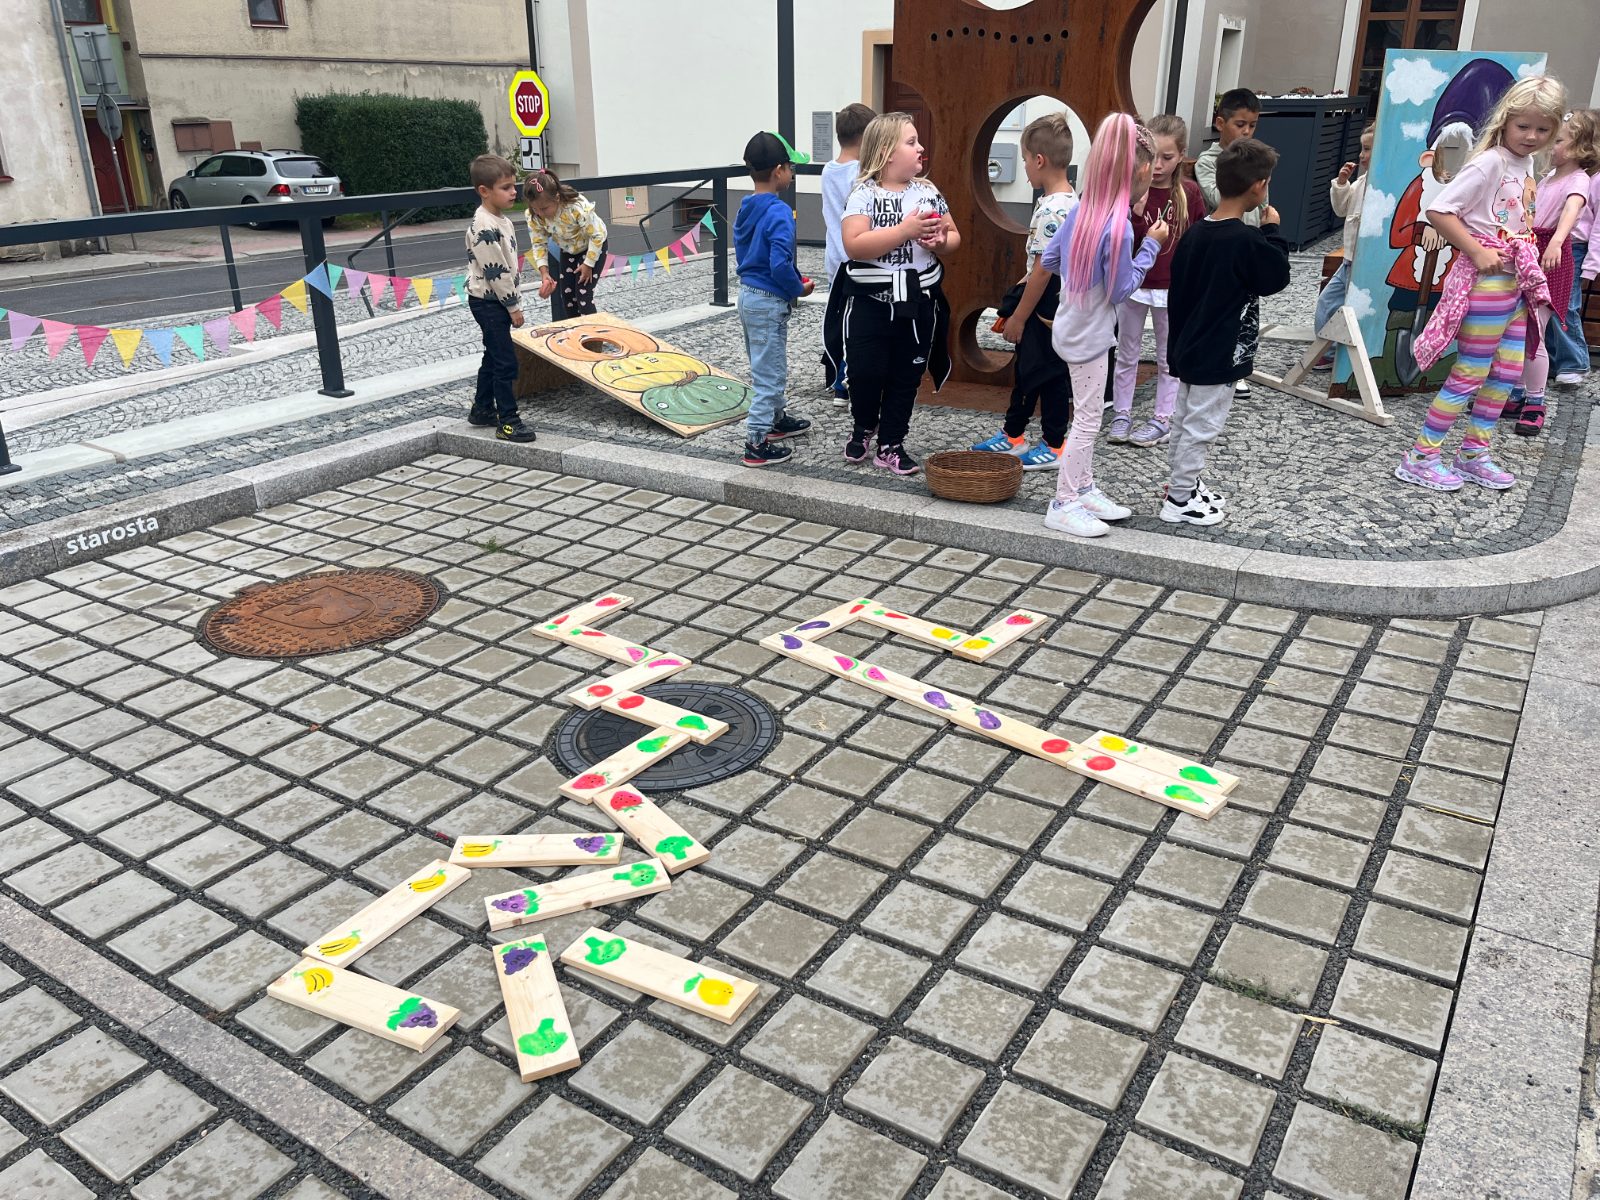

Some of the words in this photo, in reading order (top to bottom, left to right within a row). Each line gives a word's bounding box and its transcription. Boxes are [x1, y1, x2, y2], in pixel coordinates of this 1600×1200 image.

[517, 95, 541, 113] STOP
[873, 198, 903, 213] NEW
[872, 213, 904, 228] YORK
[66, 517, 159, 555] starosta
